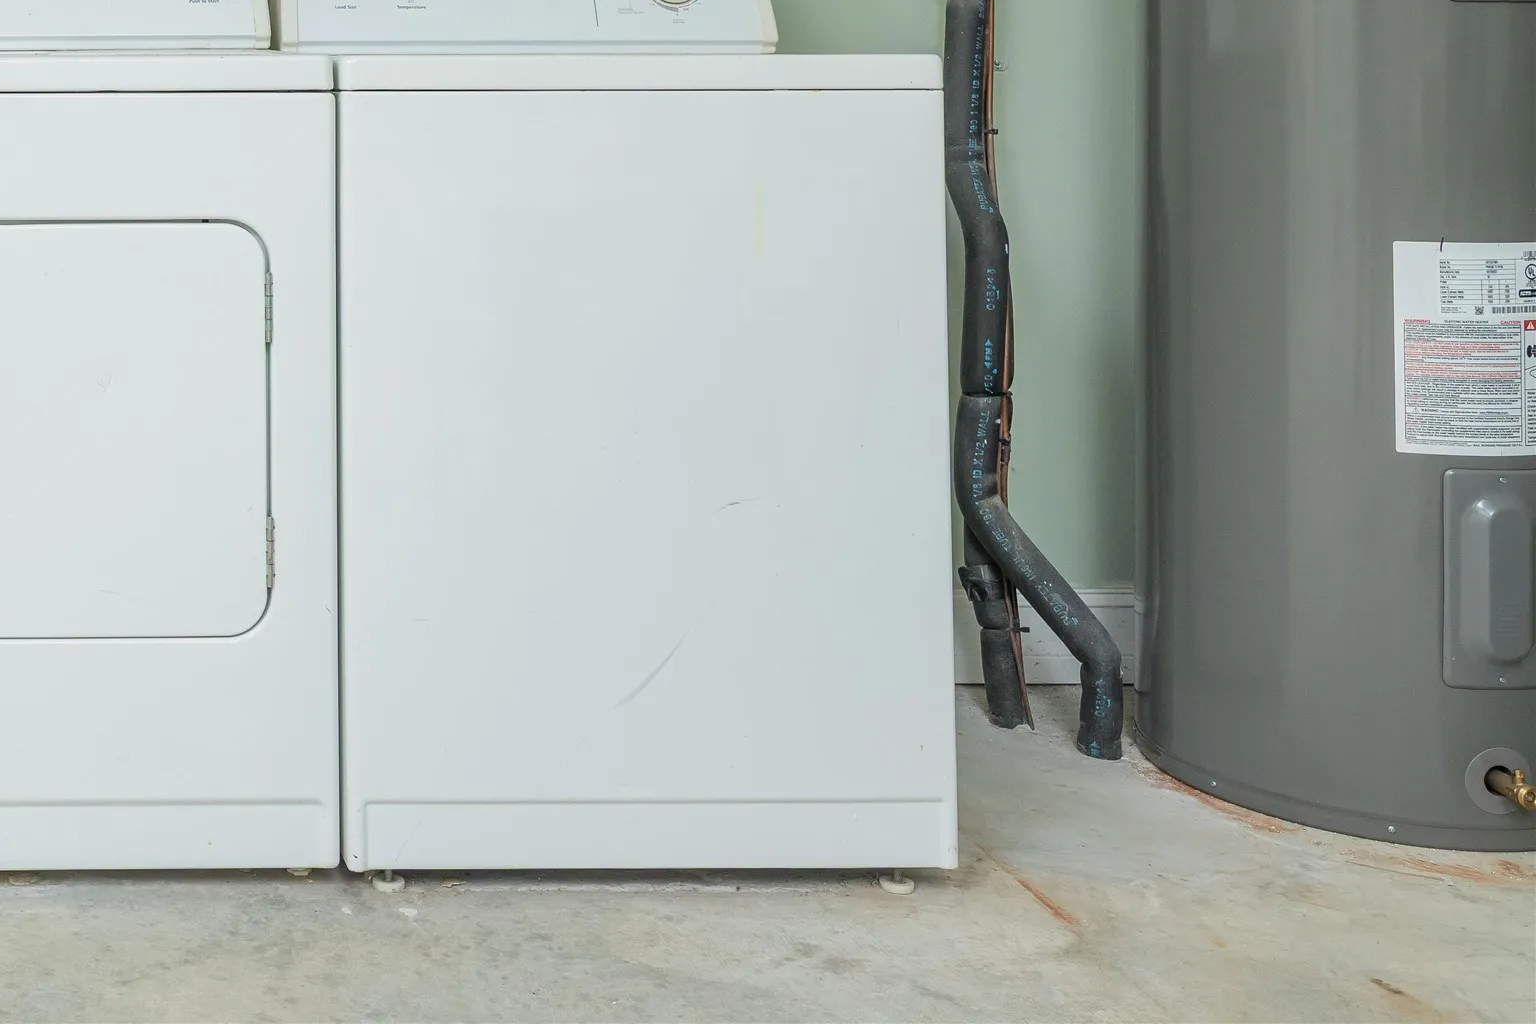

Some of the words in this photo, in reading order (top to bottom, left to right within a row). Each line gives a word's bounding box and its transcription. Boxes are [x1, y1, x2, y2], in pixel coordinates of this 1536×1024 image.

[974, 24, 984, 50] WALL
[973, 54, 982, 67] 1/2
[976, 409, 991, 437] WALL
[974, 441, 985, 456] 1/2
[972, 483, 983, 498] 1/8
